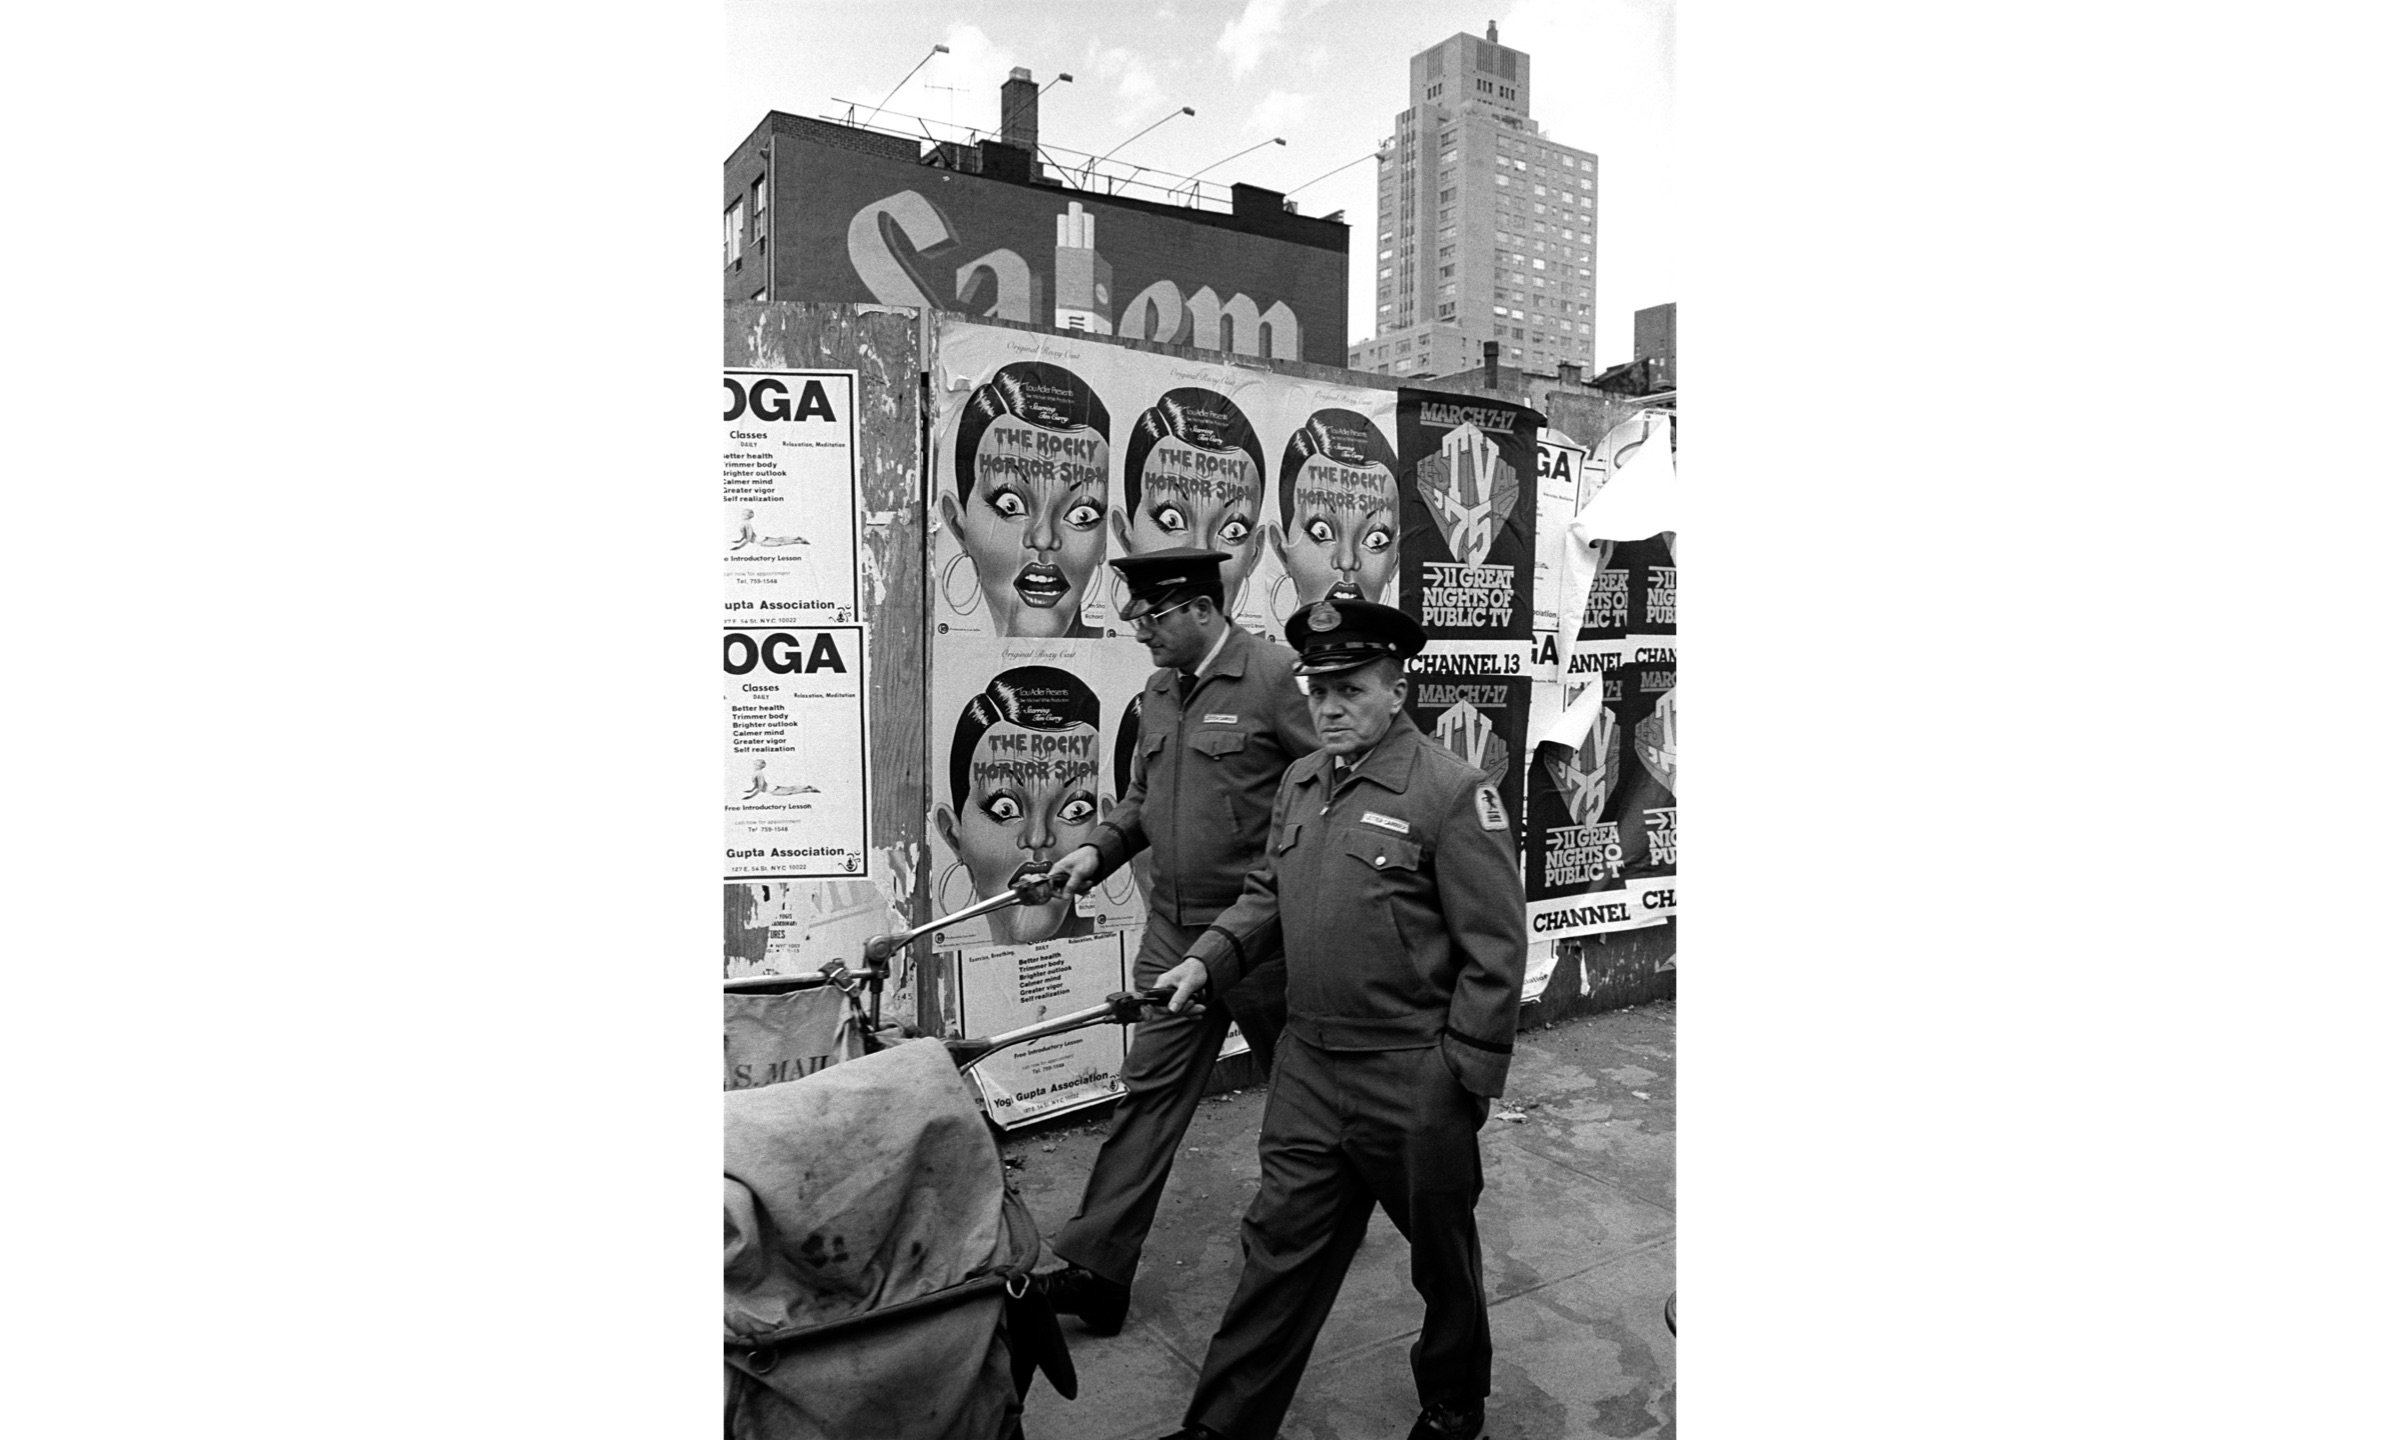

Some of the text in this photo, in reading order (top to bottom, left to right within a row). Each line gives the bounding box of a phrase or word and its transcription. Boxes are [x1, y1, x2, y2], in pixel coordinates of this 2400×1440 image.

[1420, 401, 1518, 430] MARCH 7-17
[729, 430, 768, 440] Classes
[994, 427, 1100, 462] THE ROCKY
[756, 461, 778, 469] body
[979, 453, 1055, 480] HORROR
[1159, 448, 1249, 481] THE ROCKY
[1145, 472, 1212, 498] HORROR
[1308, 466, 1388, 493] THE ROCKY
[754, 486, 776, 495] vigor
[1297, 488, 1355, 511] HORROR
[1459, 568, 1514, 589] GREAT
[1591, 574, 1629, 593] REA
[759, 600, 836, 610] Association
[1422, 587, 1514, 608] NIGHTS OF
[1422, 606, 1513, 628] PUBLIC TV
[1001, 649, 1033, 661] Original
[1059, 650, 1077, 659] Cast
[1408, 653, 1520, 675] CHANNEL 13
[742, 683, 780, 692] Classes
[1045, 687, 1069, 696] Presents
[1418, 684, 1480, 703] MARCH
[732, 722, 766, 730] Brighter
[768, 713, 789, 721] body
[734, 745, 796, 754] Self realization
[766, 738, 787, 746] vigor
[988, 734, 1094, 758] THE ROCKY
[974, 760, 1050, 781] HORROR
[724, 804, 740, 812] Free
[742, 803, 787, 811] Introductory
[726, 846, 845, 859] Gupta Association
[1545, 845, 1604, 869] NIGHTS
[1544, 863, 1605, 887] PUBLIC
[1533, 903, 1631, 932] CHANNEL
[1018, 952, 1062, 966] Better health
[1019, 959, 1065, 973] Trimmer body
[1019, 965, 1072, 981] Brighter outlook
[1019, 974, 1062, 989] Calmer mind
[1020, 982, 1063, 996] Greater vigor
[1020, 988, 1070, 1004] Self realization
[1014, 1038, 1083, 1060] Free Introductory Lesson
[994, 1095, 1014, 1108] Yogi
[1015, 1086, 1046, 1102] Gupta
[1050, 1072, 1108, 1093] Association
